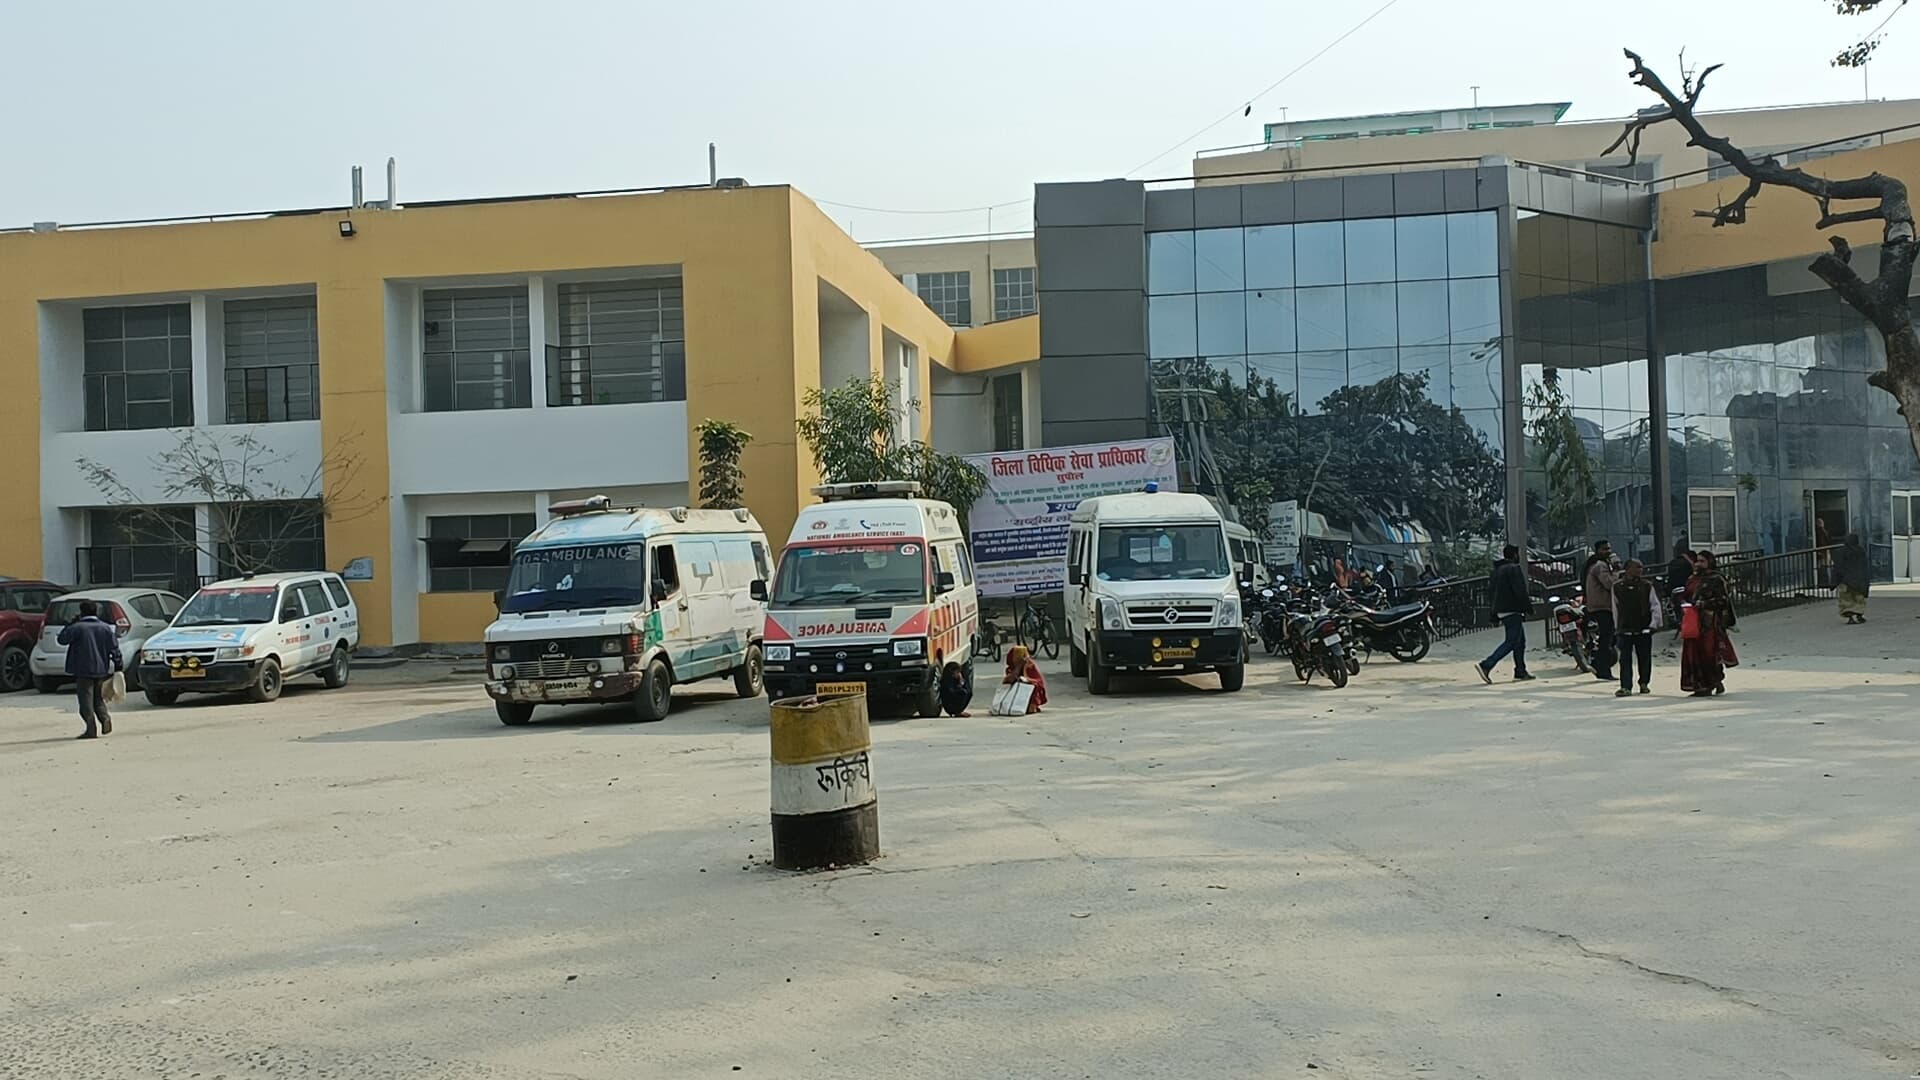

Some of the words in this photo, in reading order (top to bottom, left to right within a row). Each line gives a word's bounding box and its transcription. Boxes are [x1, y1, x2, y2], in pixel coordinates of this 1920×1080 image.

[992, 457, 1023, 477] जिला
[1027, 453, 1066, 475] विधिक
[1069, 450, 1094, 470] सेवा
[1097, 447, 1147, 468] प्राधिकार
[542, 546, 628, 563] AMBULANC
